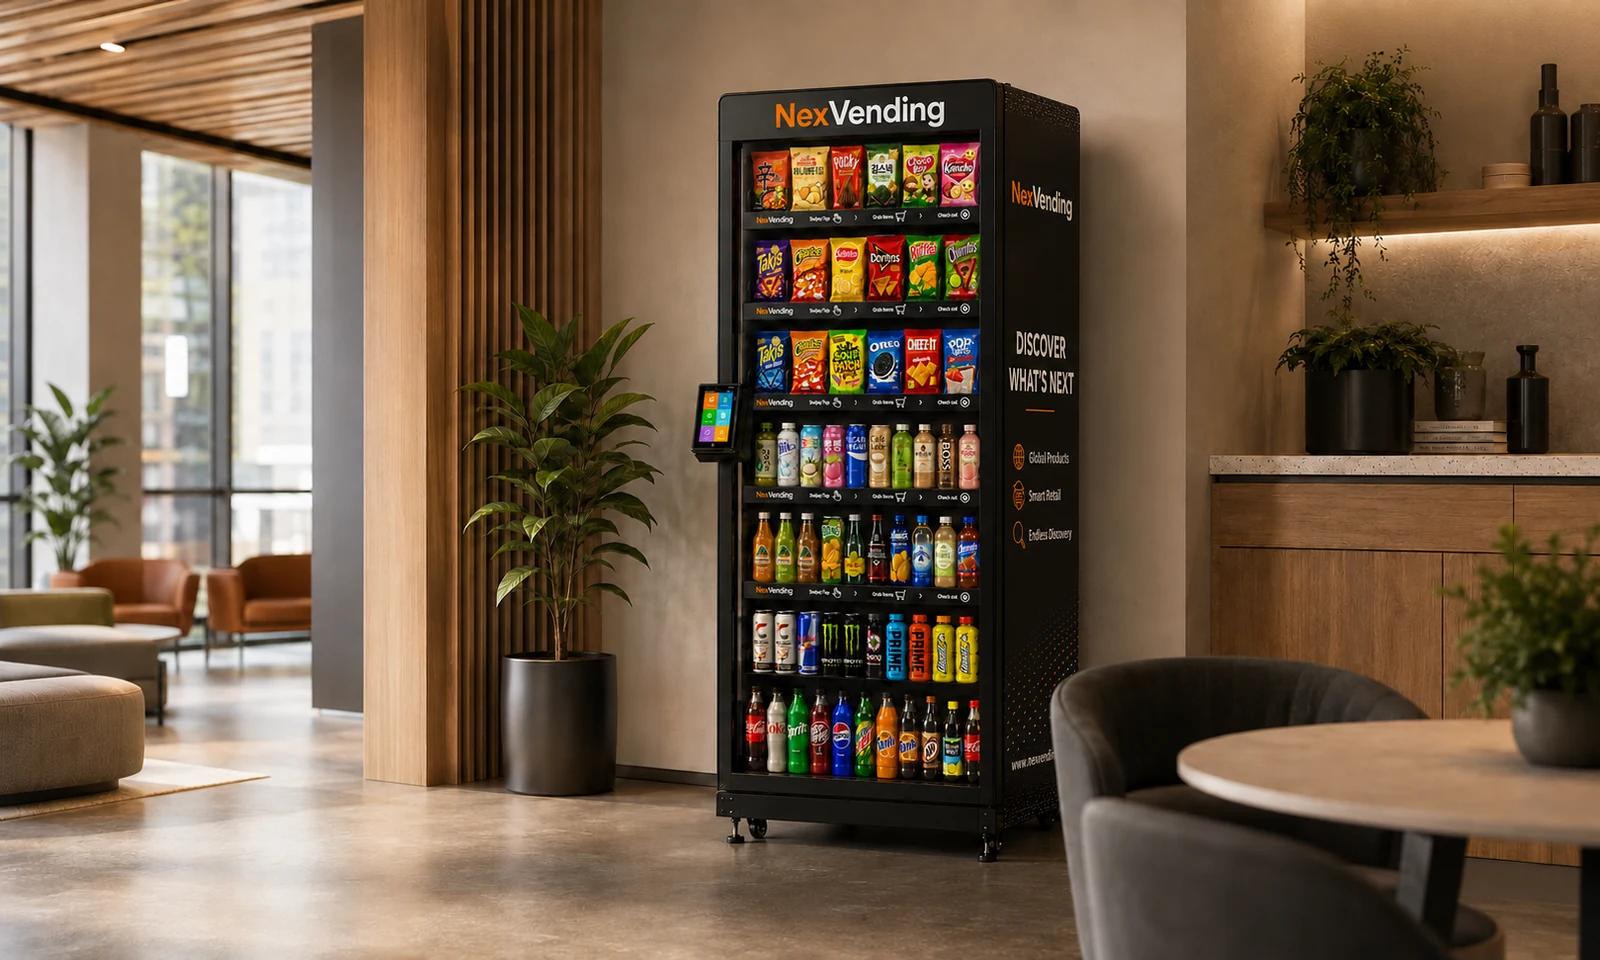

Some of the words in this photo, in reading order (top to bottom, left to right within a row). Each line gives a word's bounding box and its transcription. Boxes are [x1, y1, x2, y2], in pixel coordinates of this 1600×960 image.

[775, 95, 946, 128] NexVending
[1011, 180, 1073, 222] NexVending
[757, 251, 783, 275] Takis
[757, 343, 784, 367] Takis
[869, 340, 900, 352] OREO
[1016, 330, 1066, 360] DISCOVER
[1008, 367, 1047, 393] WHAT'S
[1049, 370, 1074, 394] NEXT
[941, 442, 951, 470] BOSS
[1028, 451, 1047, 464] Global
[1047, 452, 1070, 464] Products
[1028, 489, 1045, 502] Smart
[1046, 488, 1061, 501] Retail
[1028, 528, 1048, 541] Endless
[1048, 528, 1072, 541] Discovery
[888, 630, 903, 672] PRIME
[912, 631, 925, 673] PRIME
